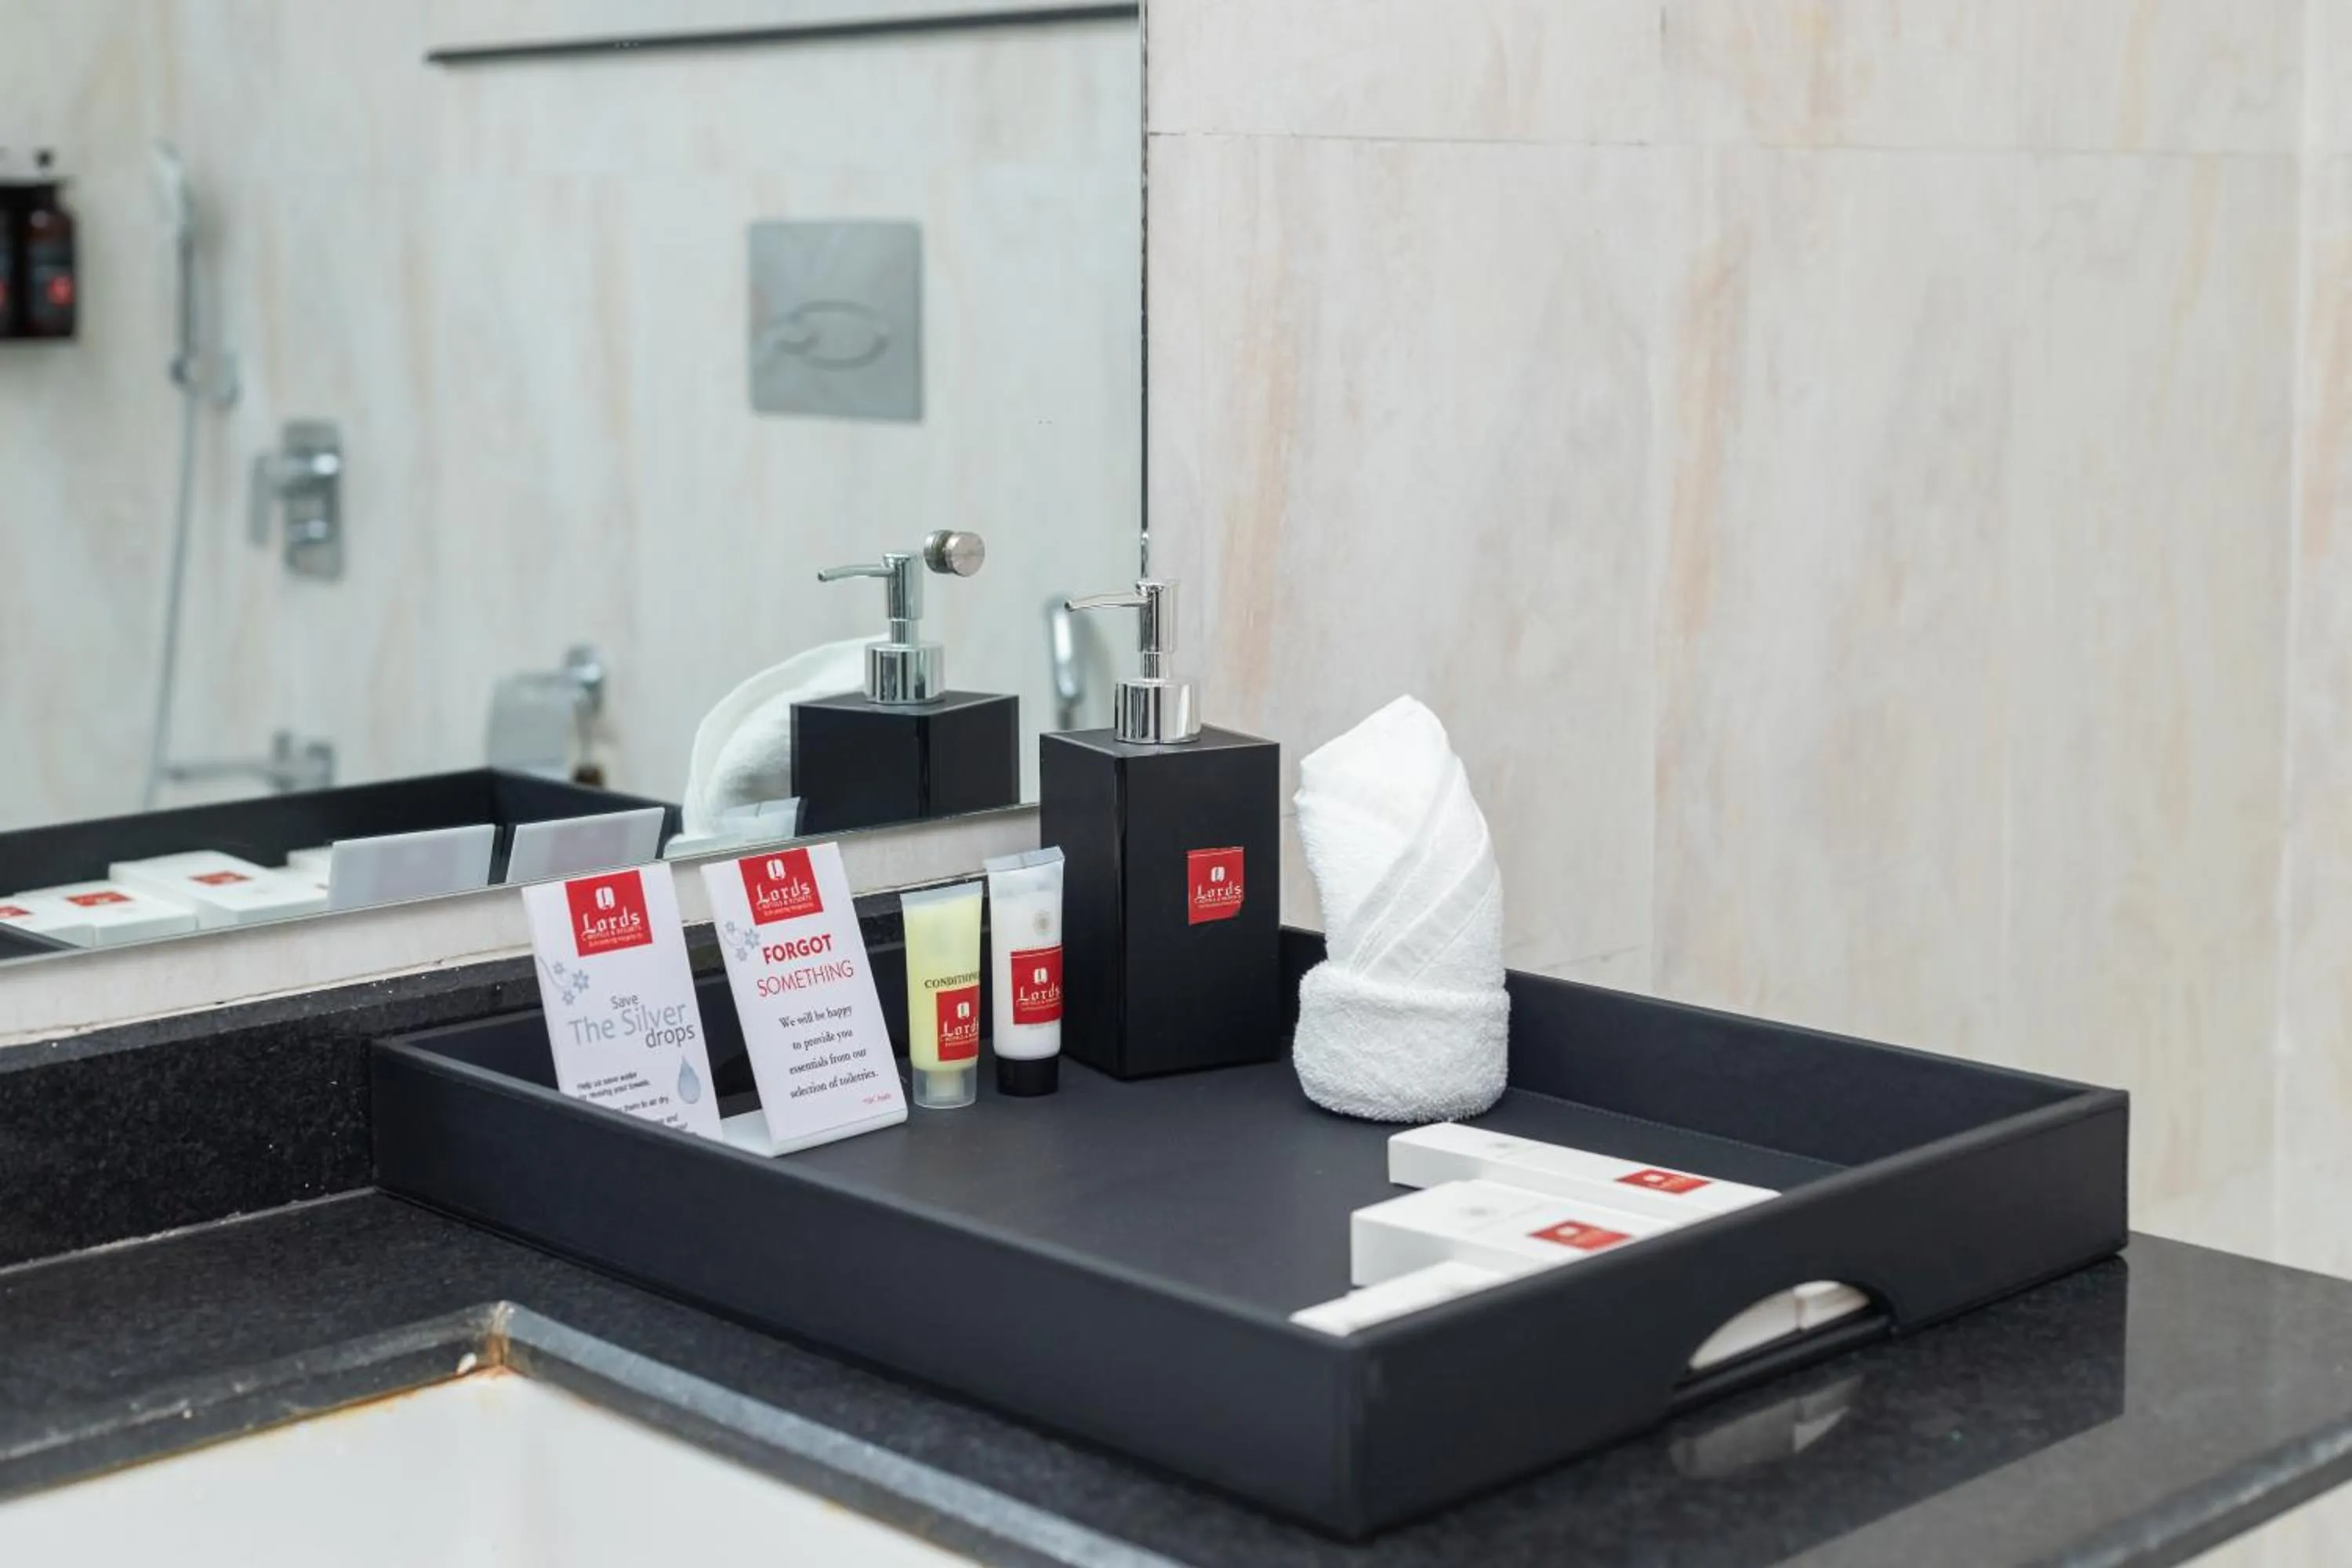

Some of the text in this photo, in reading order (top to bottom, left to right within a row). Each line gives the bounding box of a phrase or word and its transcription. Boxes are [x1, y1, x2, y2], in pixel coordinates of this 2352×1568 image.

[757, 877, 811, 904] Lords
[1196, 880, 1242, 900] Lords
[583, 906, 641, 934] Lords
[762, 934, 832, 964] FORGOT
[757, 960, 854, 997] SOMETHING
[1018, 982, 1060, 1001] Lords
[610, 994, 639, 1010] Save
[568, 1003, 687, 1046] The Silver
[779, 1005, 852, 1028] We will be happy
[644, 1024, 696, 1048] drops
[793, 1029, 854, 1051] to provide you
[789, 1048, 866, 1075] essentials from our
[790, 1069, 879, 1099] selection of toiletries.
